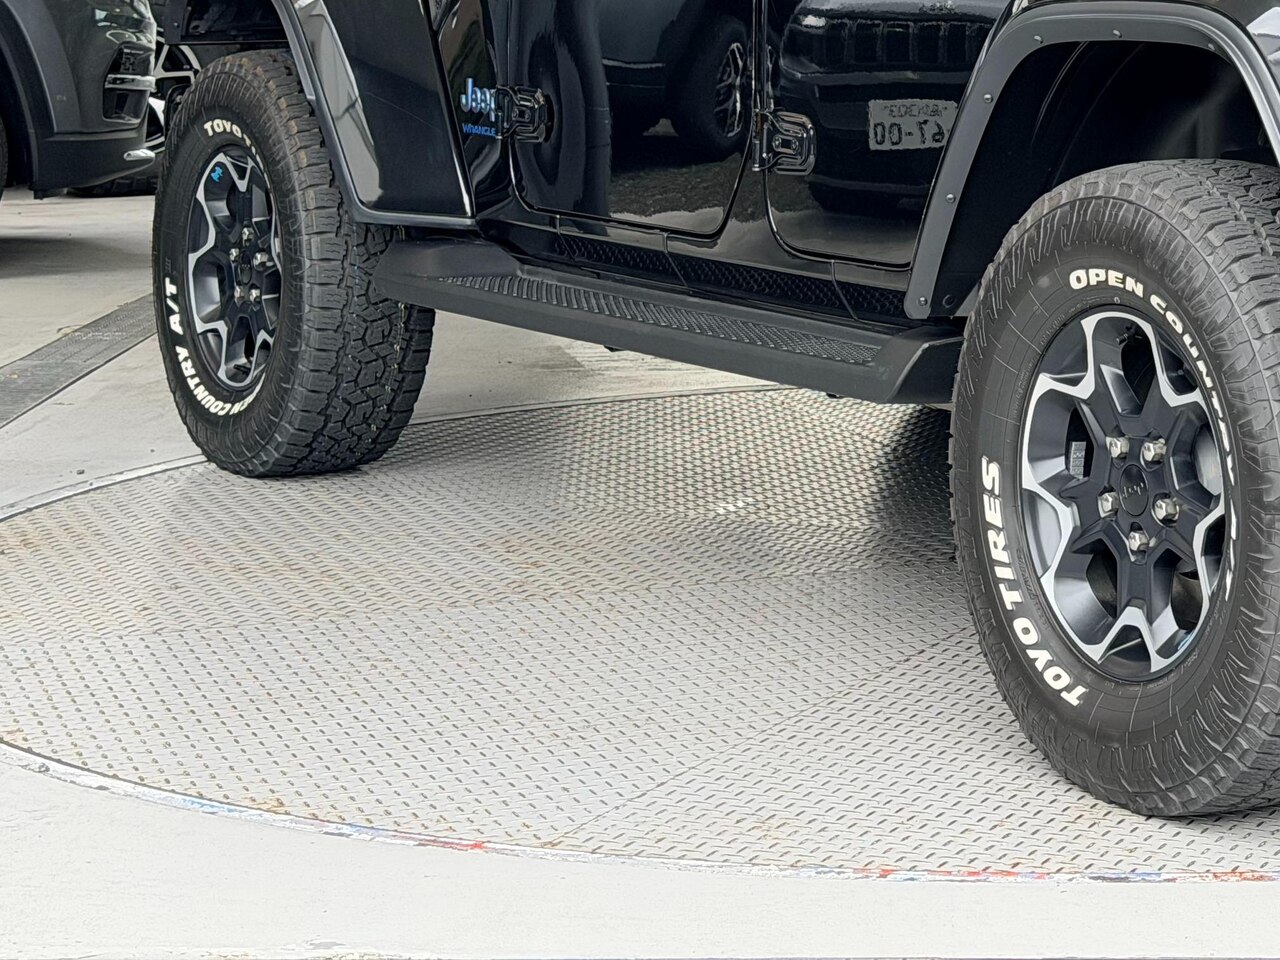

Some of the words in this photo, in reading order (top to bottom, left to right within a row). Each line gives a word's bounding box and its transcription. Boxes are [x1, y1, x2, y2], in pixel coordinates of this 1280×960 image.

[203, 118, 243, 138] TOYO
[462, 123, 497, 138] WRANGLE
[164, 277, 184, 336] A/T
[1069, 268, 1145, 299] OPEN
[174, 345, 233, 416] COUNTRY
[981, 455, 1024, 612] TIRES
[1013, 616, 1090, 707] TOYO
